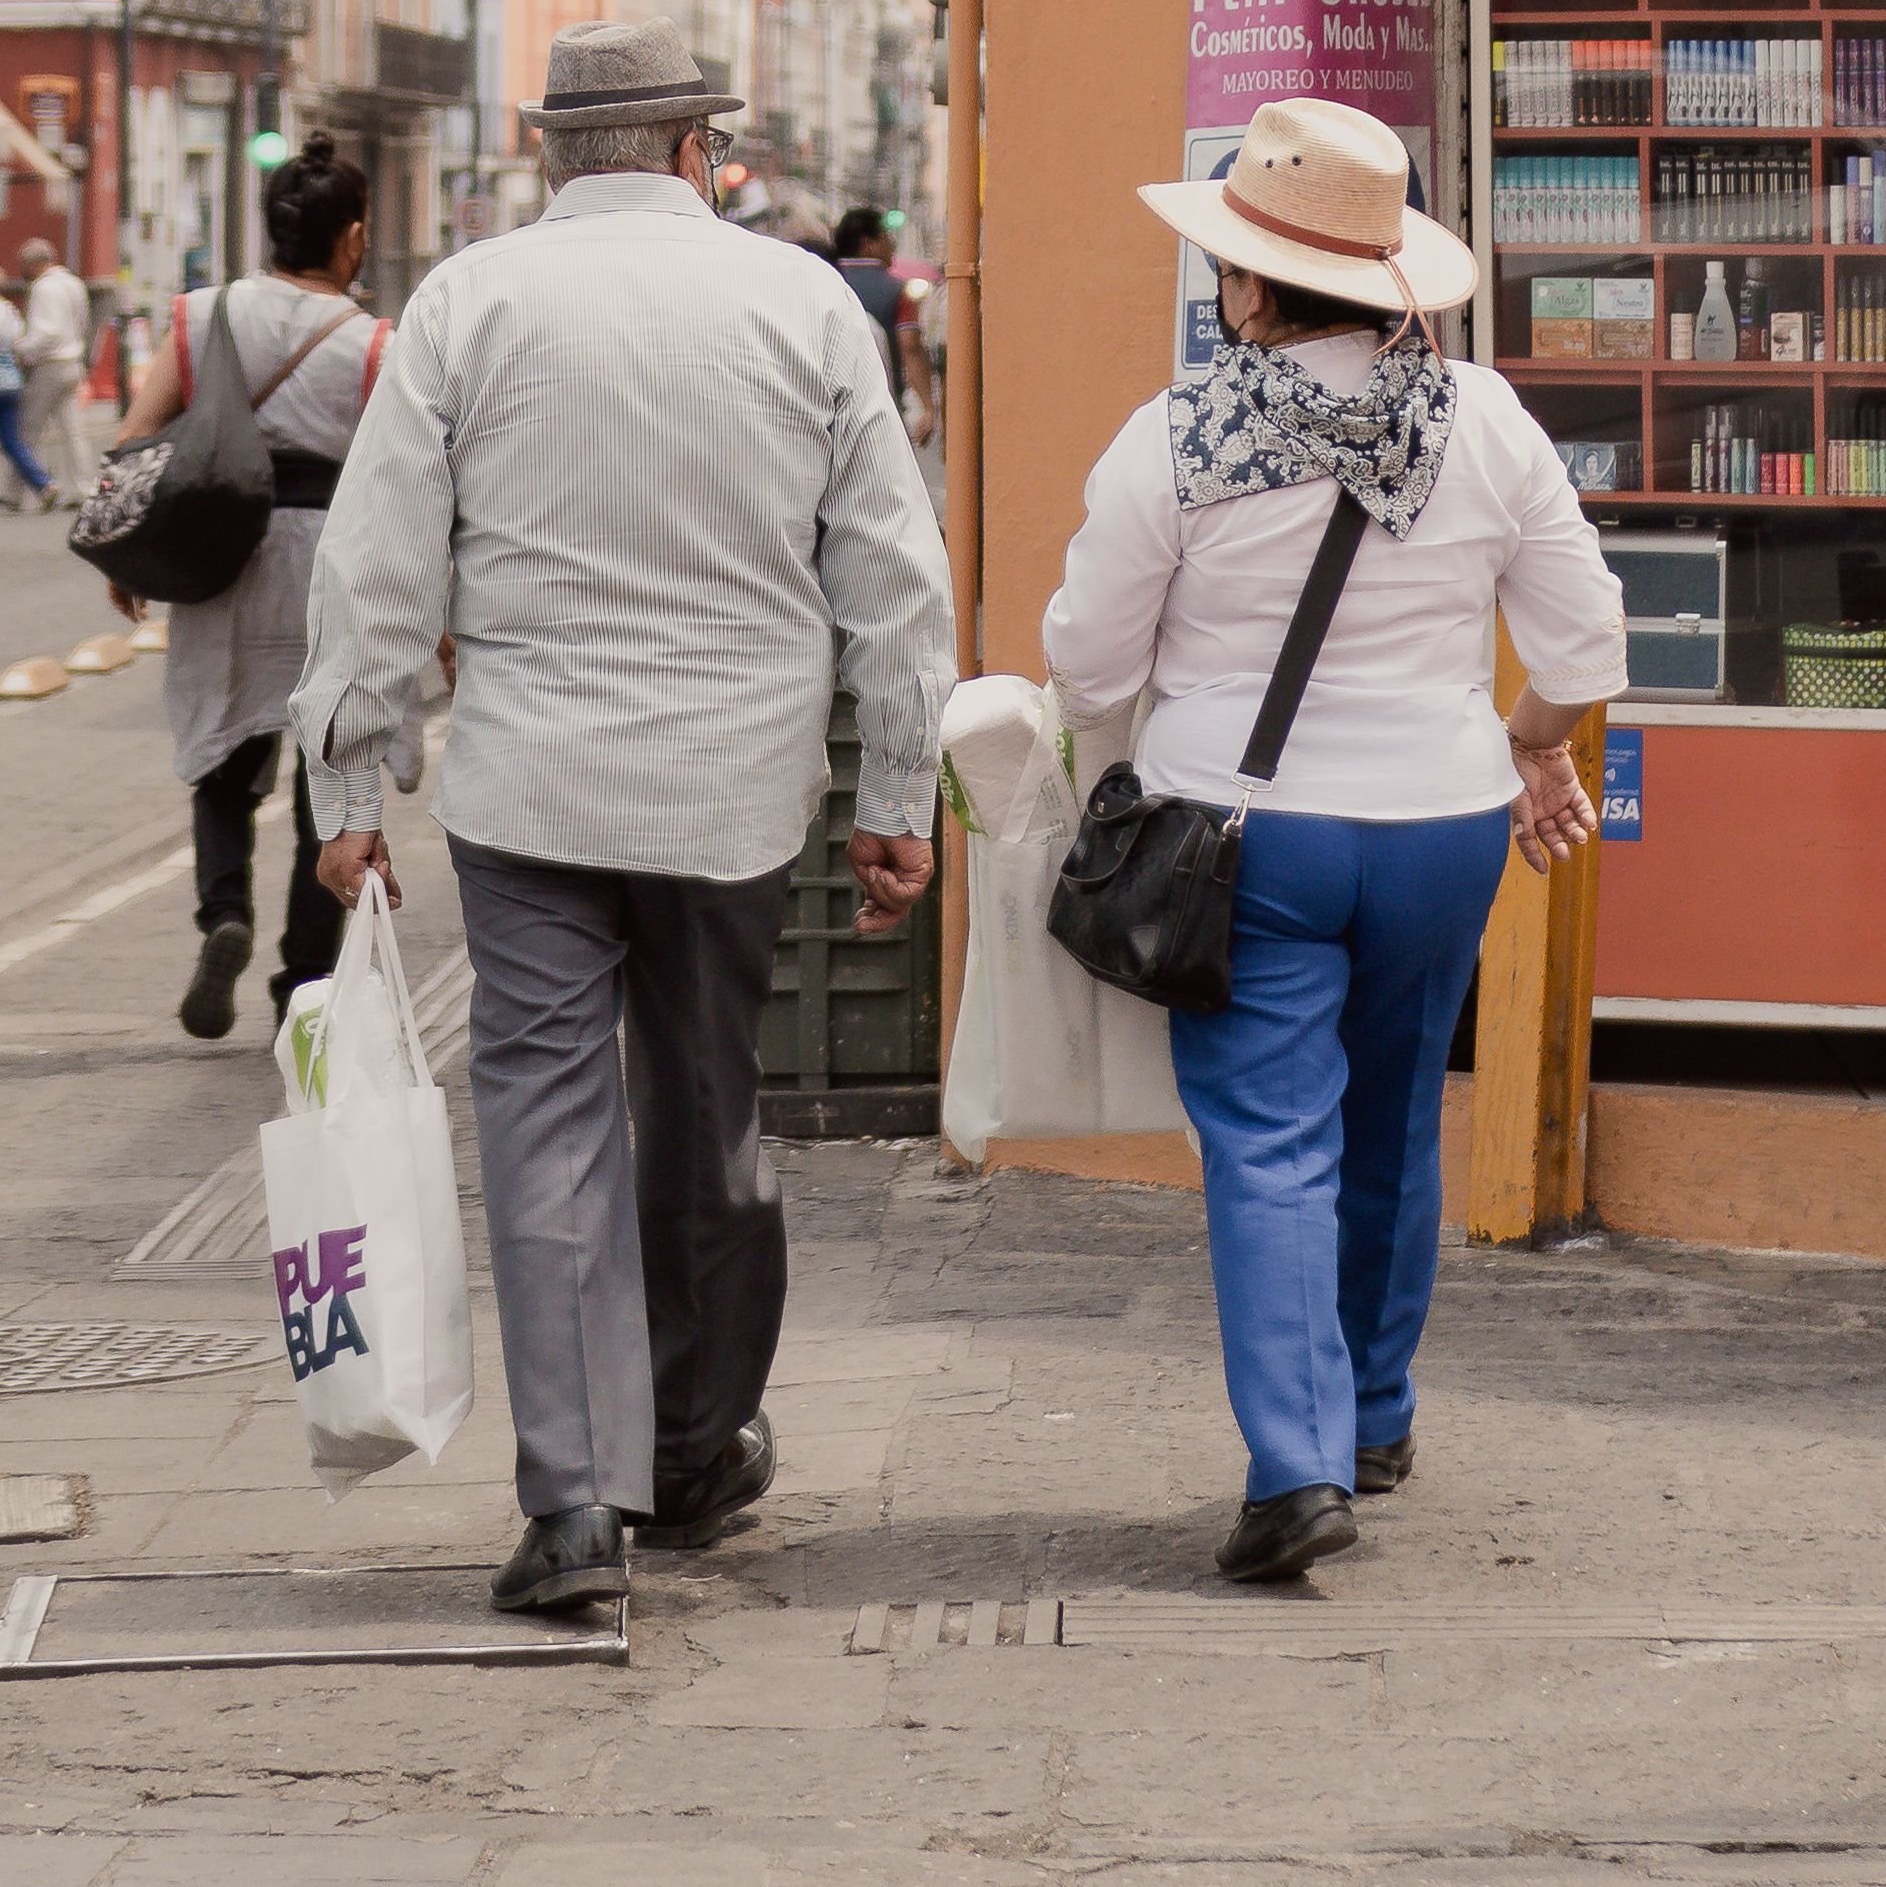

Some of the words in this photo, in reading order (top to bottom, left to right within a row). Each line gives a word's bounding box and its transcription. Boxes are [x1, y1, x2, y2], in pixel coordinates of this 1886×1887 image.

[1222, 69, 1314, 94] MAYOREO
[1320, 70, 1331, 89] Y
[1336, 69, 1413, 91] MENUDEO
[1196, 305, 1218, 320] DES
[1196, 324, 1223, 339] CAL
[1601, 797, 1640, 820] ISA
[273, 1223, 368, 1320] PUE
[284, 1291, 370, 1382] BLA
